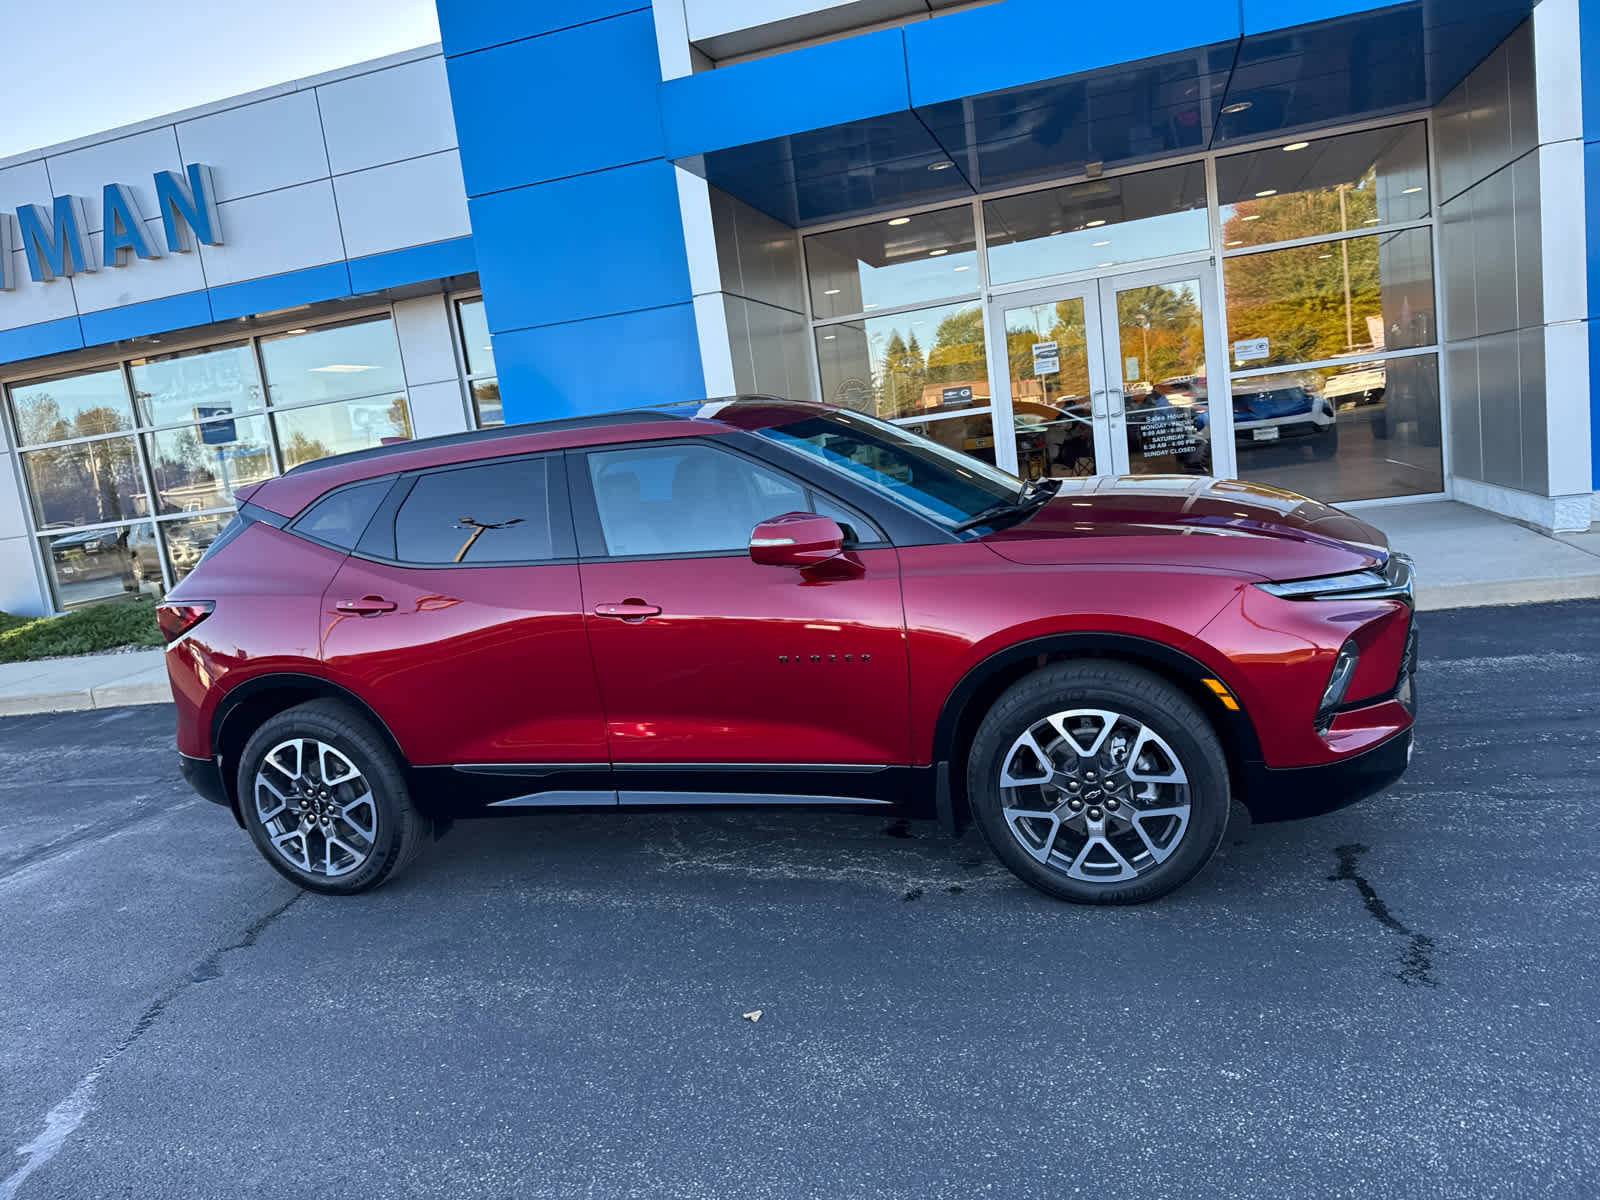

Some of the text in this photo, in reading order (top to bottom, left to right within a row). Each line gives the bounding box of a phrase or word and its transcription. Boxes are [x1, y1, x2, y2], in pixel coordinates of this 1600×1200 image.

[0, 163, 224, 291] MAN
[1152, 434, 1185, 442] SATURDAY
[1170, 446, 1196, 454] CLOSED
